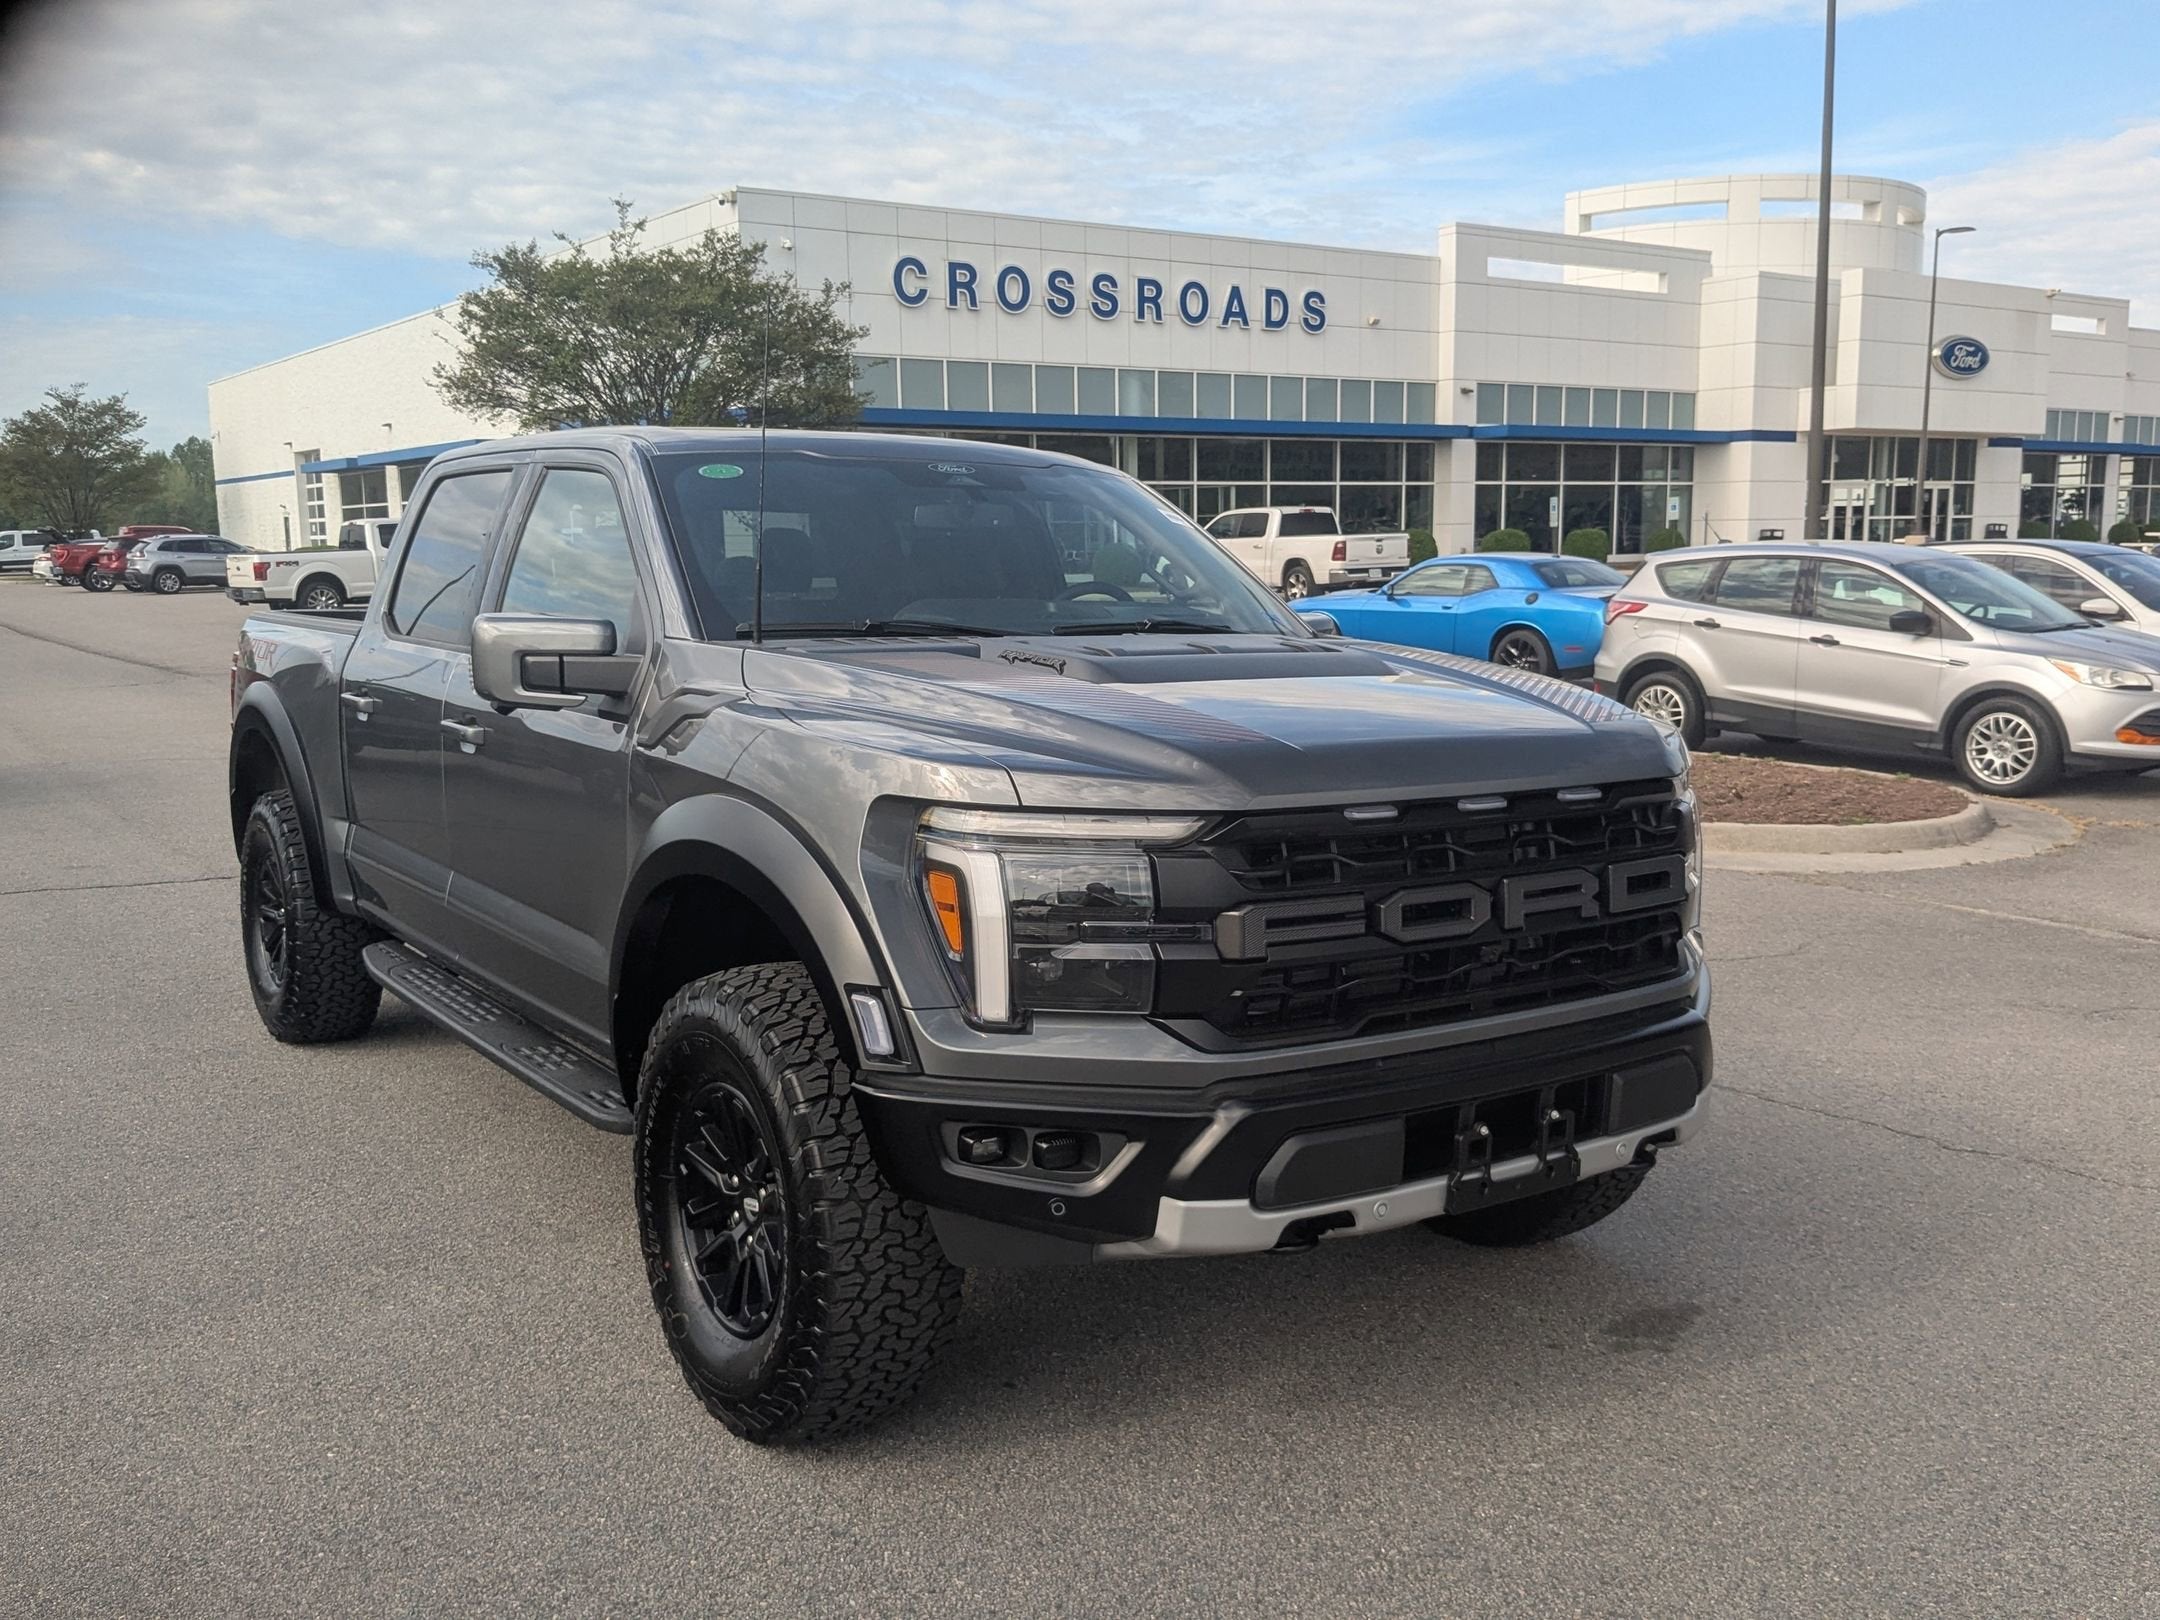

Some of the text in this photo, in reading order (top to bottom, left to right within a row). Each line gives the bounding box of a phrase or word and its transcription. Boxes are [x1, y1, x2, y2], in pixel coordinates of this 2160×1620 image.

[892, 254, 1329, 335] CROSSROADS
[1950, 344, 1982, 368] Ford
[937, 464, 968, 473] Ford
[998, 650, 1067, 675] RAPTOR
[1215, 854, 1689, 963] FORD
